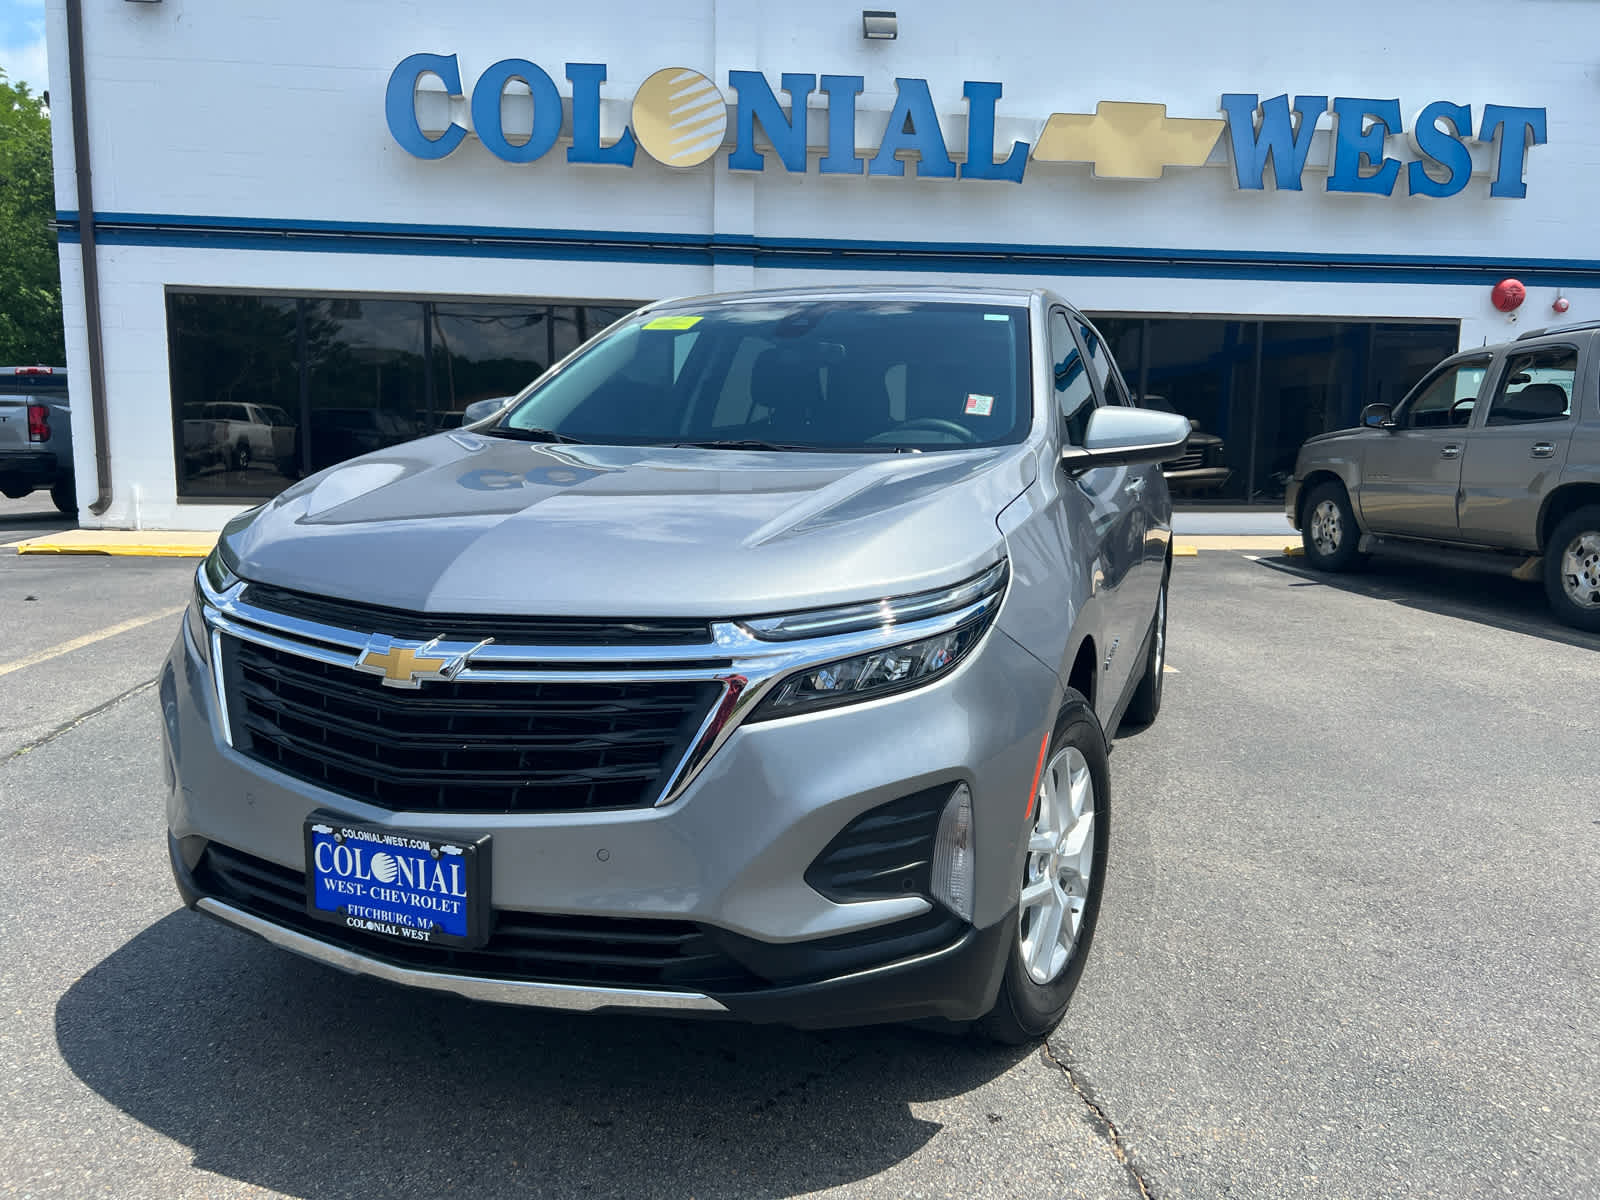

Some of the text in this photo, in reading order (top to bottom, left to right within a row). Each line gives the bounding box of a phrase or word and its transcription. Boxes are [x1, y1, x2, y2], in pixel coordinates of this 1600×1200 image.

[385, 52, 1548, 200] COLONIAL WEST
[341, 828, 431, 851] COLONIAL-WEST.COM
[314, 841, 468, 898] COLONIAL
[346, 917, 431, 942] COLONIAL WEST
